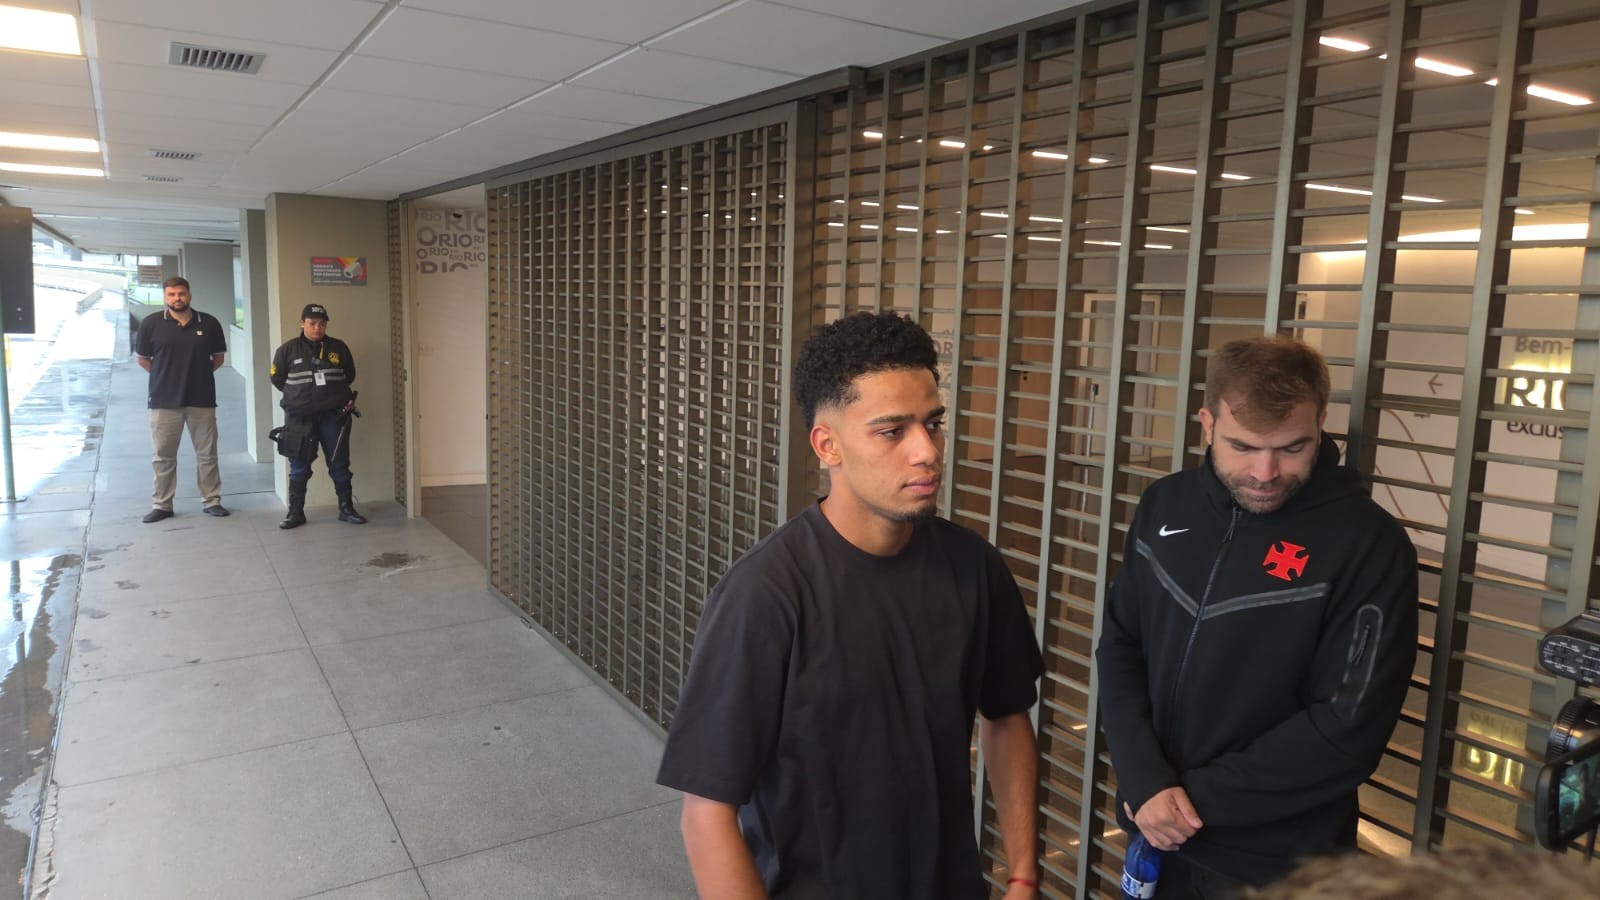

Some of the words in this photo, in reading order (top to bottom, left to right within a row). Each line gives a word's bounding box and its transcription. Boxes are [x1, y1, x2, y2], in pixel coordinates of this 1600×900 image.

[439, 233, 473, 248] RIO
[429, 247, 449, 256] RIO
[463, 251, 486, 262] RIO
[1515, 335, 1571, 354] Bem-
[1504, 376, 1567, 410] RI
